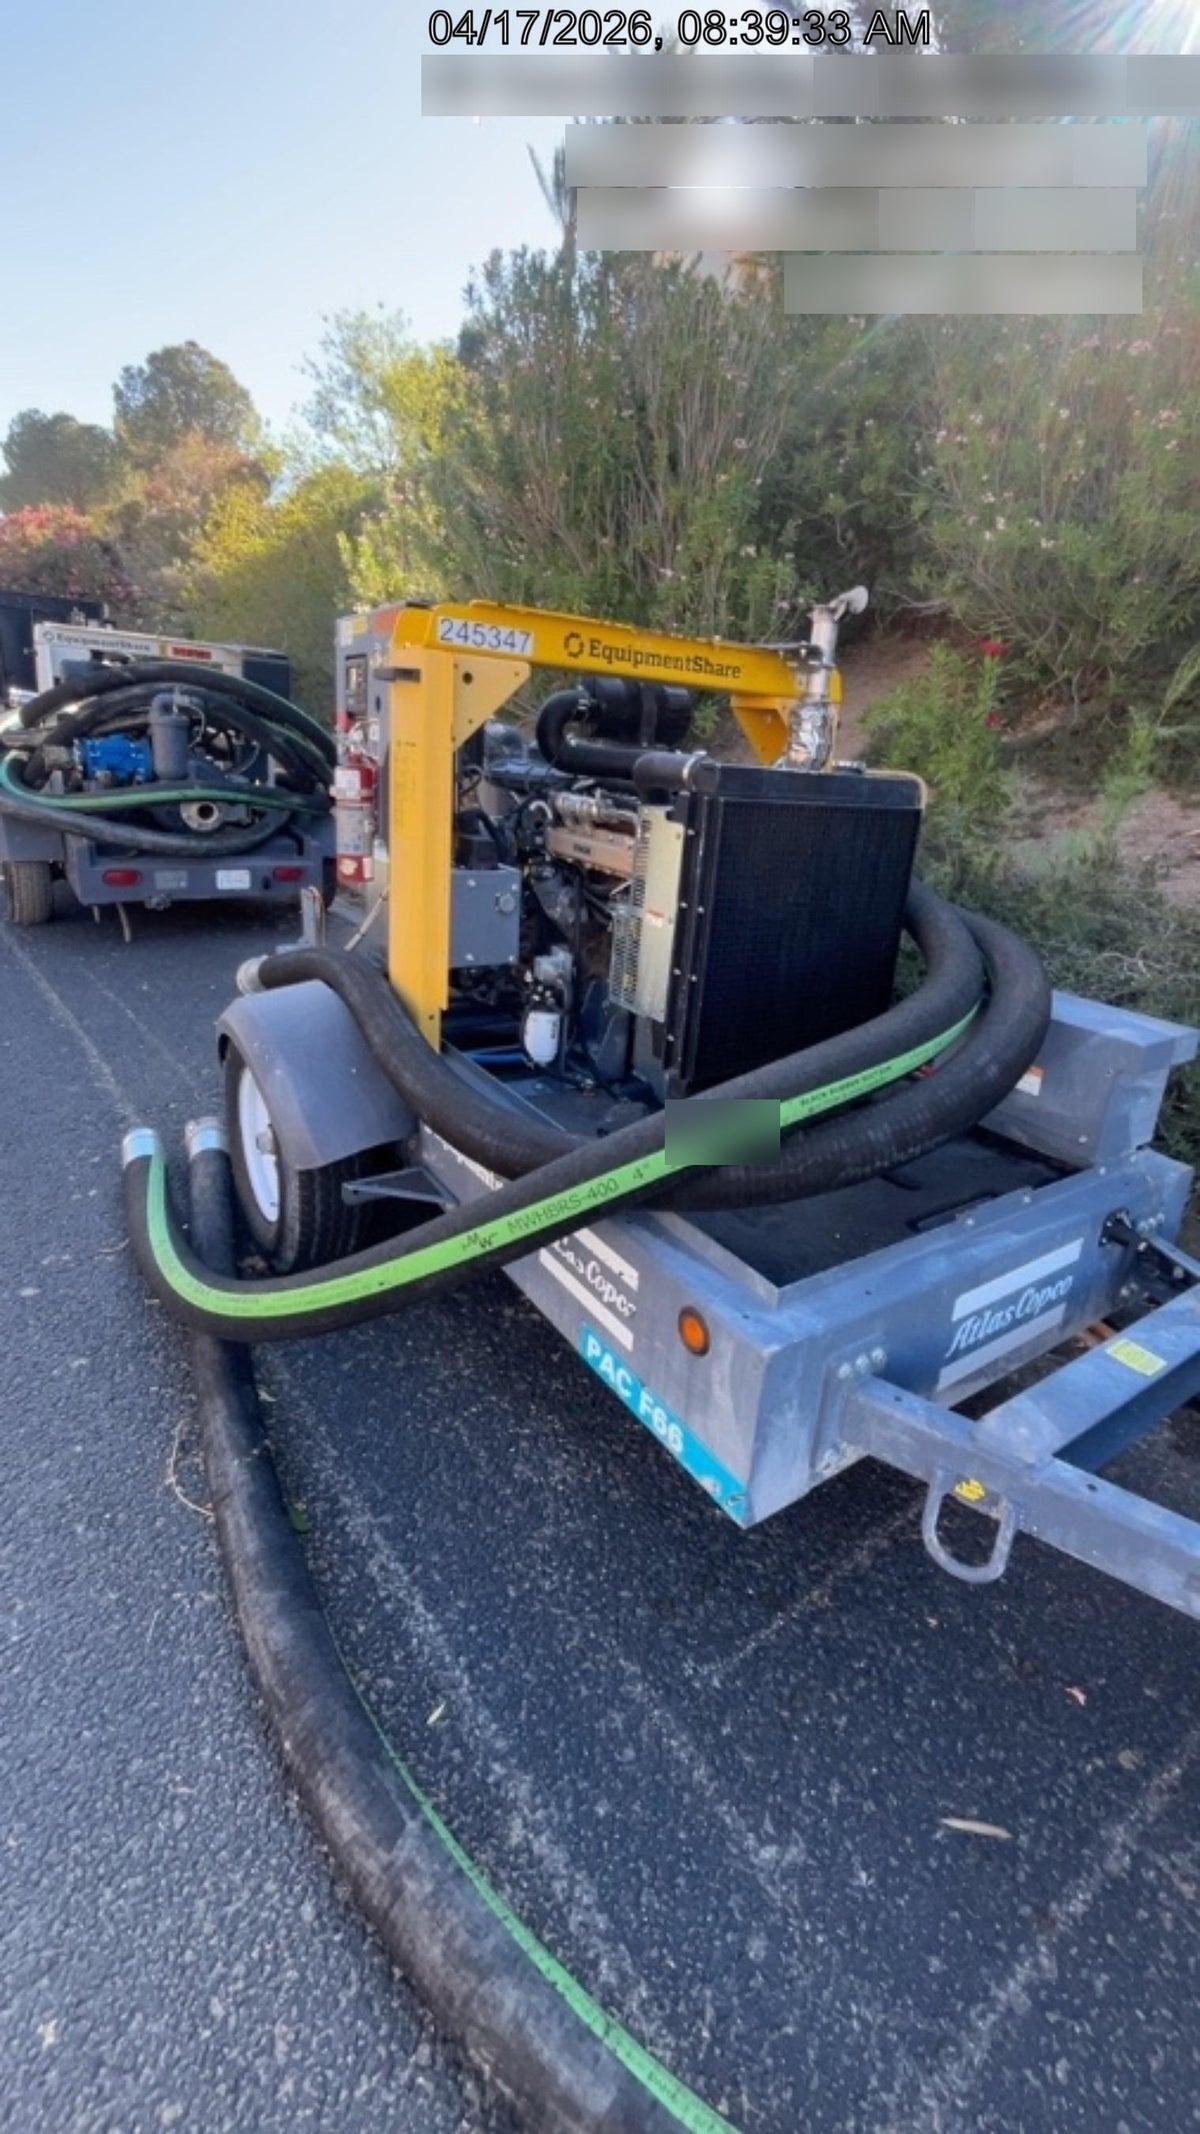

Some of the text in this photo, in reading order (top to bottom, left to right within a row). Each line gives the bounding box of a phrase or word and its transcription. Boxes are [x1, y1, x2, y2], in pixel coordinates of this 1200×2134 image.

[440, 618, 532, 653] 245347
[588, 638, 741, 679] EquipmentShare
[945, 1274, 1075, 1358] Atlas Copco
[586, 1333, 684, 1453] PAC F66
